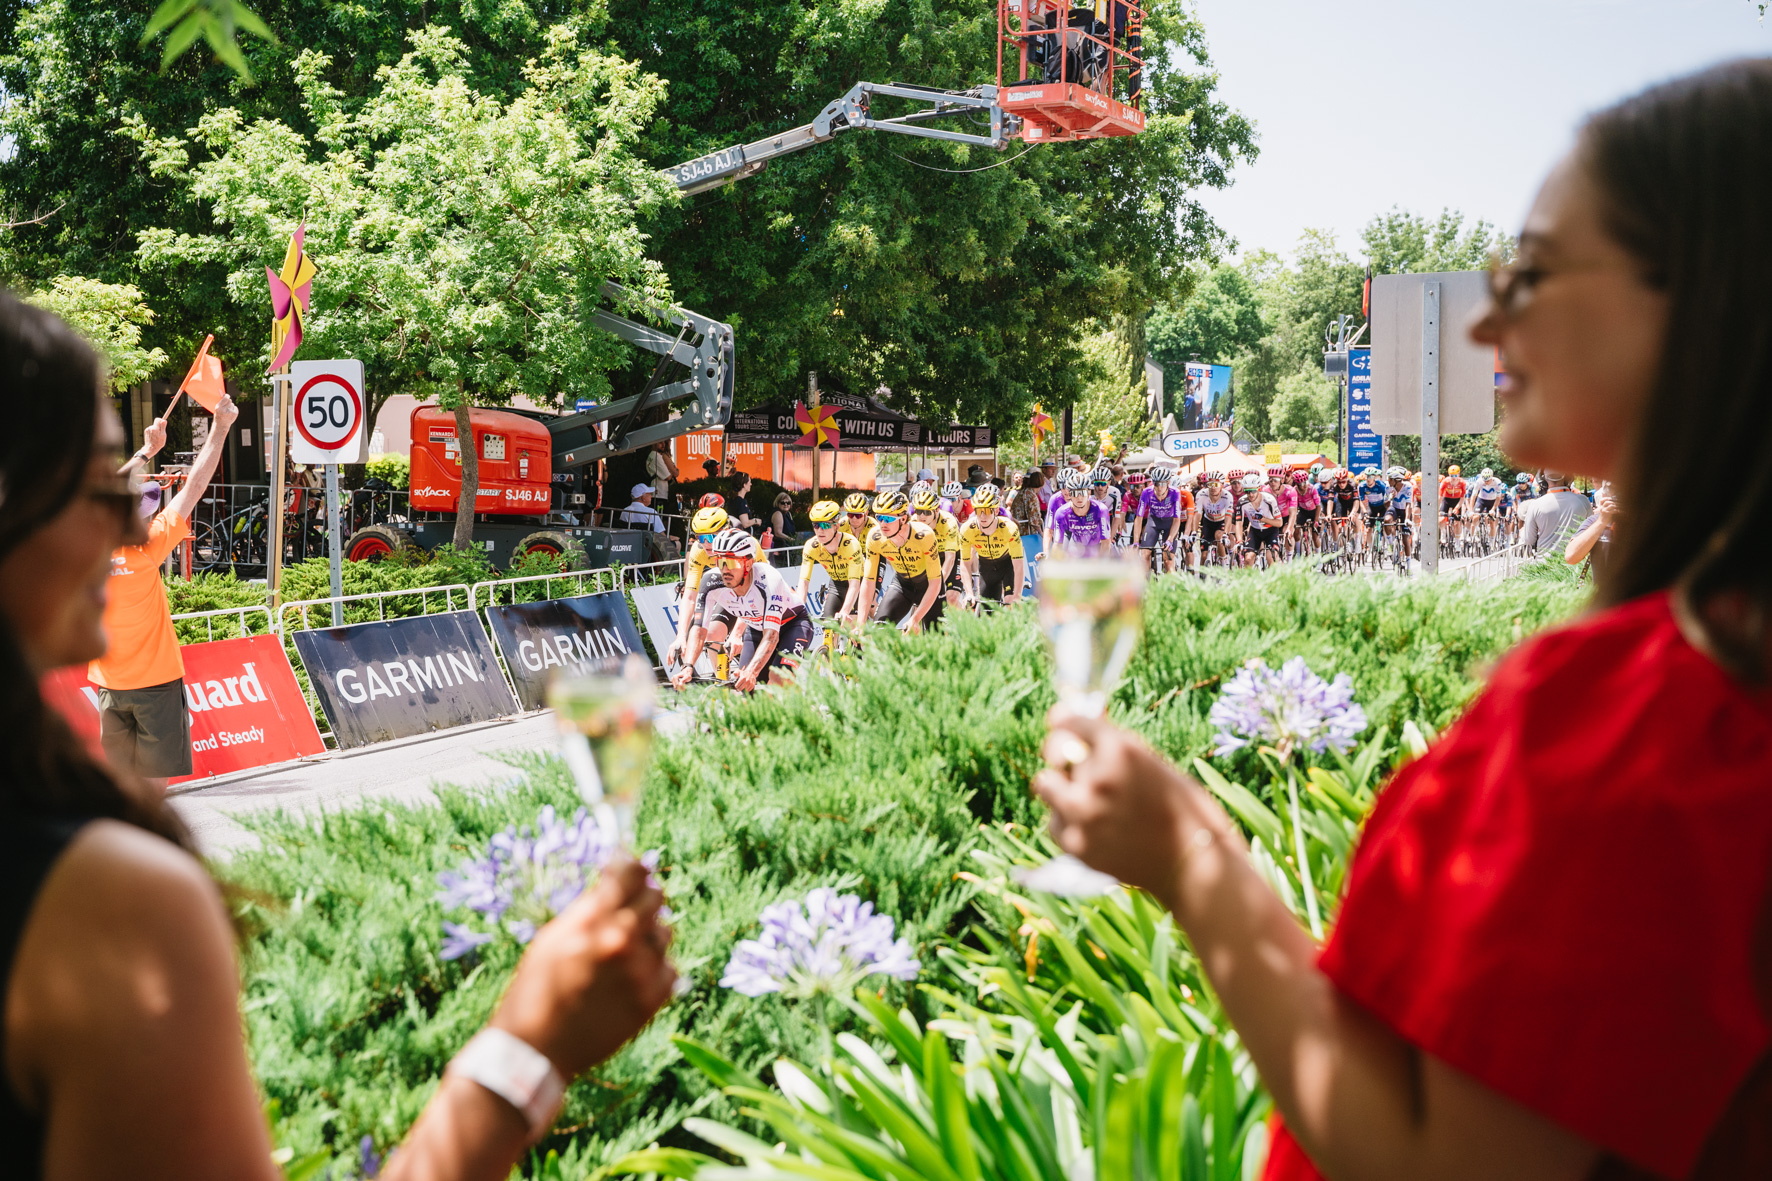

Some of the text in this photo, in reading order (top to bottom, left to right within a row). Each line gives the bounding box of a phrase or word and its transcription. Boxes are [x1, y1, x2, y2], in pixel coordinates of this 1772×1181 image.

[715, 152, 731, 171] AJ
[308, 395, 349, 429] 50
[845, 419, 876, 436] WITH
[878, 422, 895, 437] US
[686, 434, 711, 455] TOUR
[1173, 437, 1219, 450] Santos
[413, 486, 451, 498] SKYJACK
[505, 489, 548, 502] SJ46 AJ
[519, 626, 628, 672] GARMIN
[336, 650, 480, 704] GARMIN
[193, 725, 265, 752] and Steady
